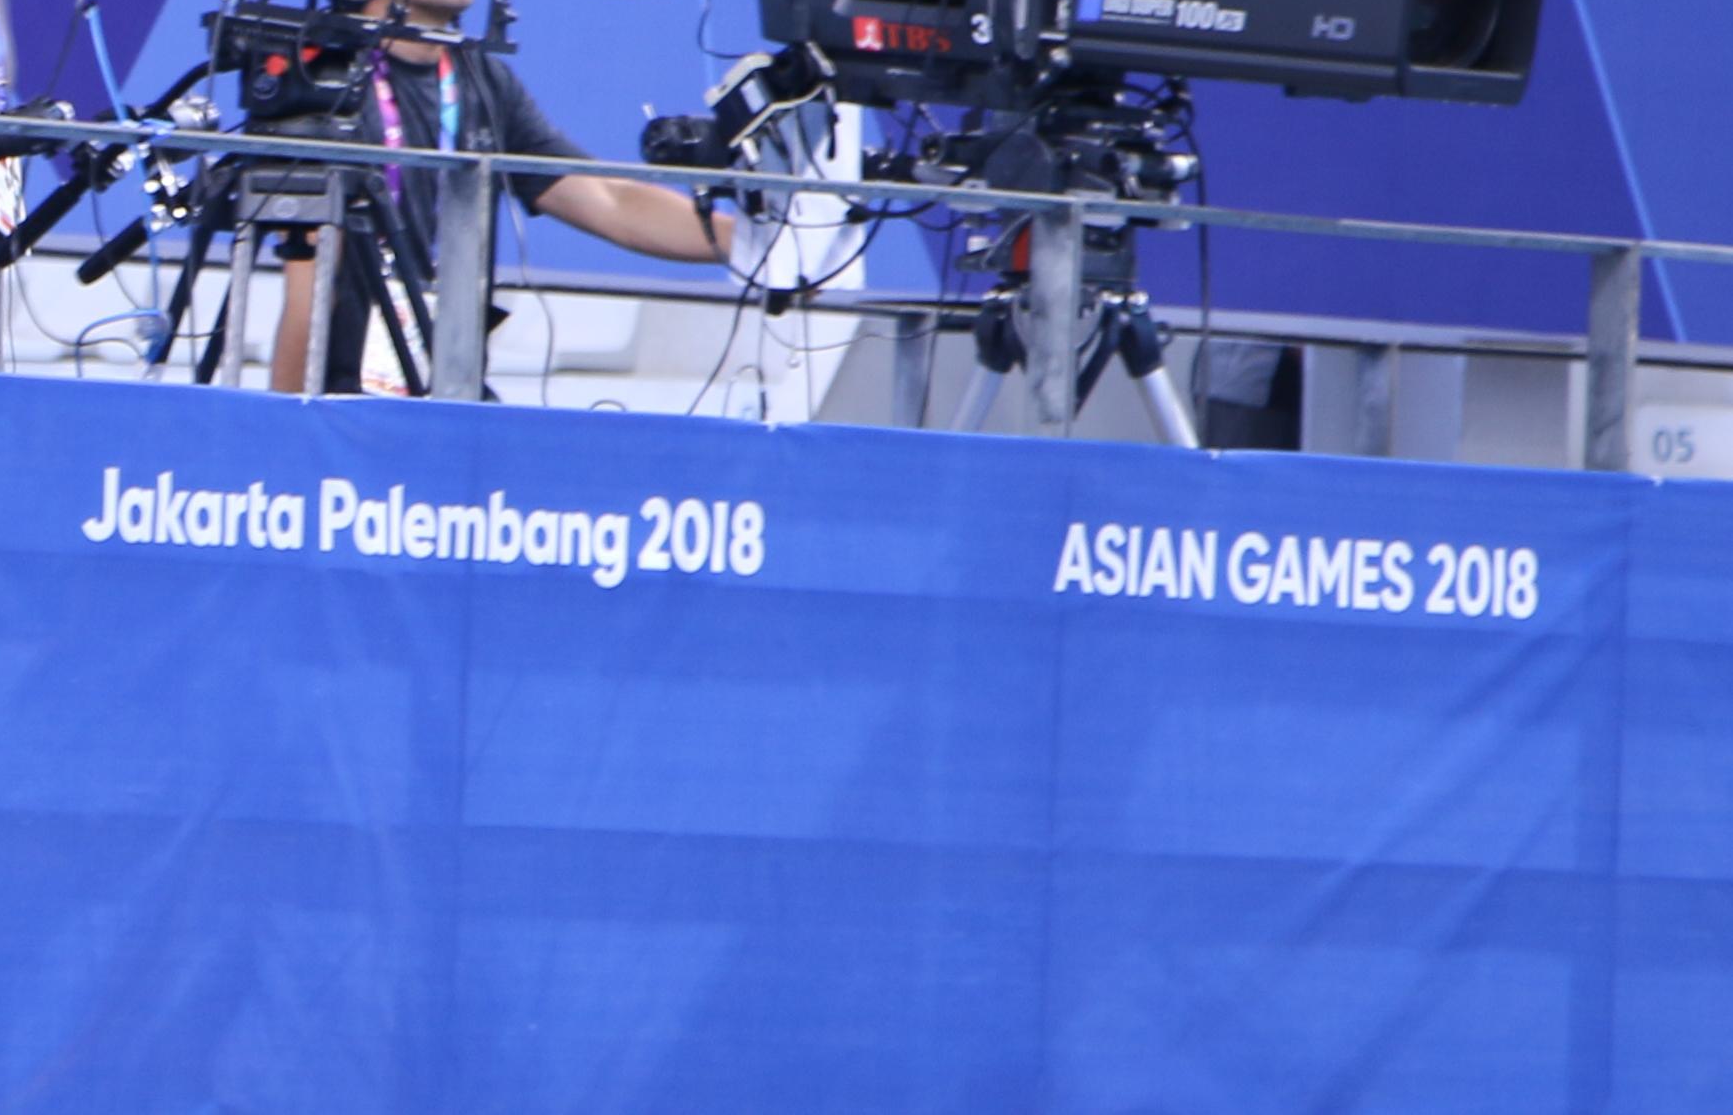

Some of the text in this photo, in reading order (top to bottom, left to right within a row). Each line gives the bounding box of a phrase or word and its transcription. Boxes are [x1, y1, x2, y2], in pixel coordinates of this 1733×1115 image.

[971, 13, 993, 44] 3
[1175, 0, 1218, 29] 100
[1312, 13, 1355, 40] HD
[1652, 428, 1696, 464] 05
[81, 466, 764, 588] Jakarta Palembang 2018
[1053, 522, 1538, 619] ASIAN GAMES 2018
